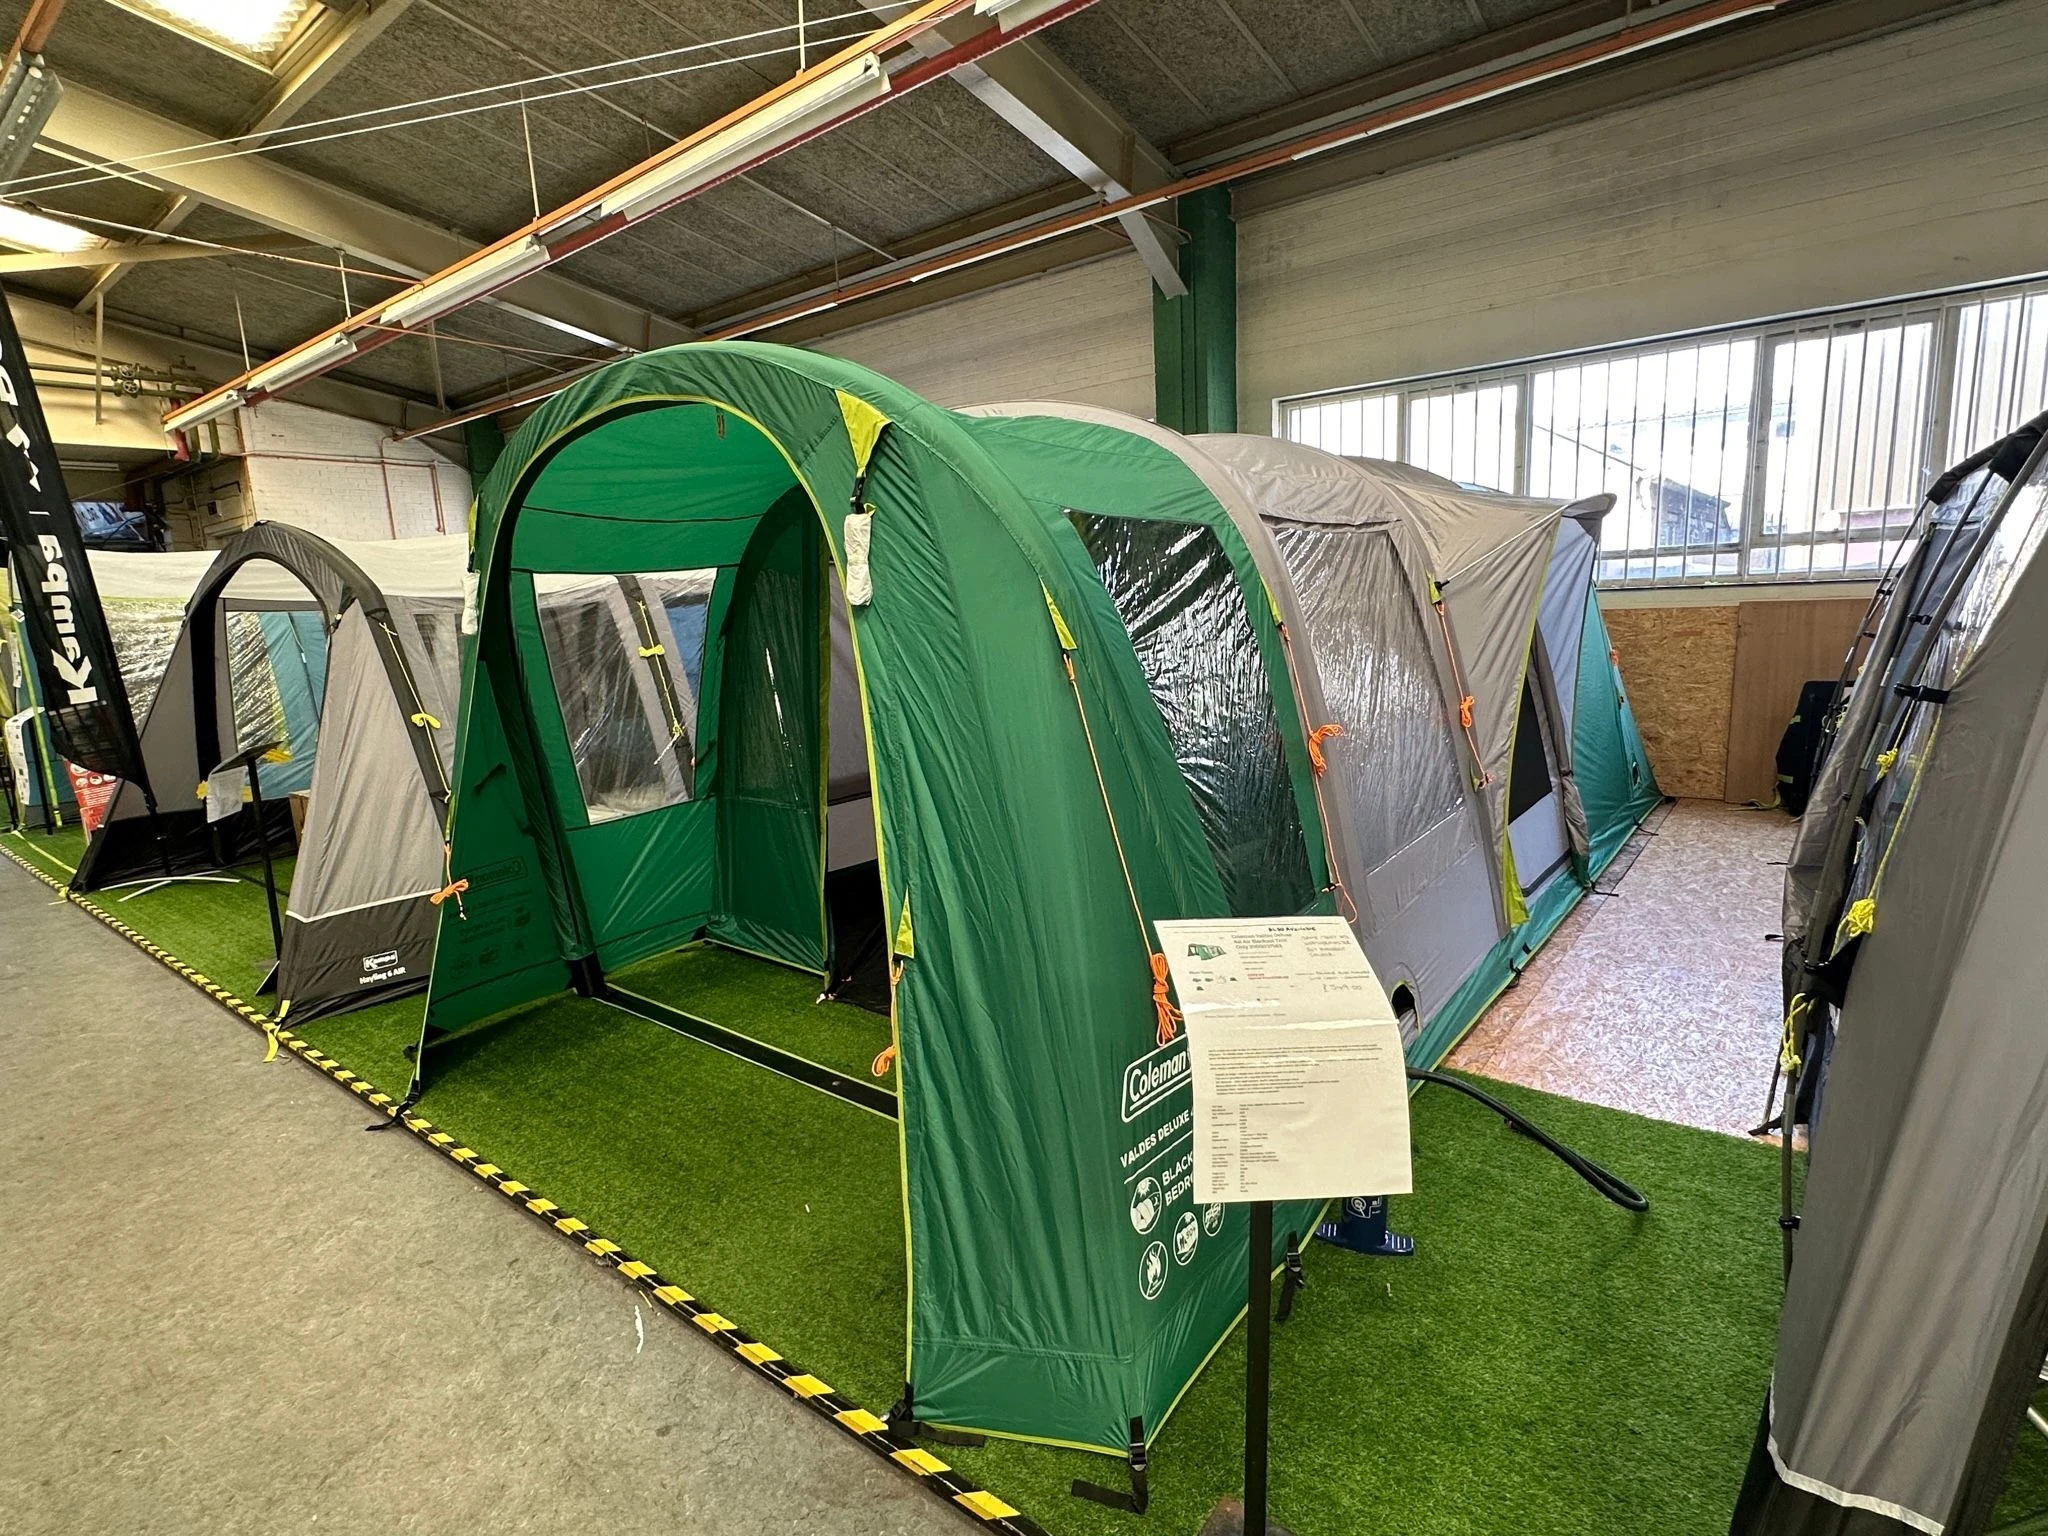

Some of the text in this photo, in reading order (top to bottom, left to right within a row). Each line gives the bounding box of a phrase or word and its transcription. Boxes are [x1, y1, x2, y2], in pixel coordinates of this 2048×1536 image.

[1129, 1051, 1187, 1102] Coleman
[1120, 1109, 1190, 1168] VALDES DELUXE
